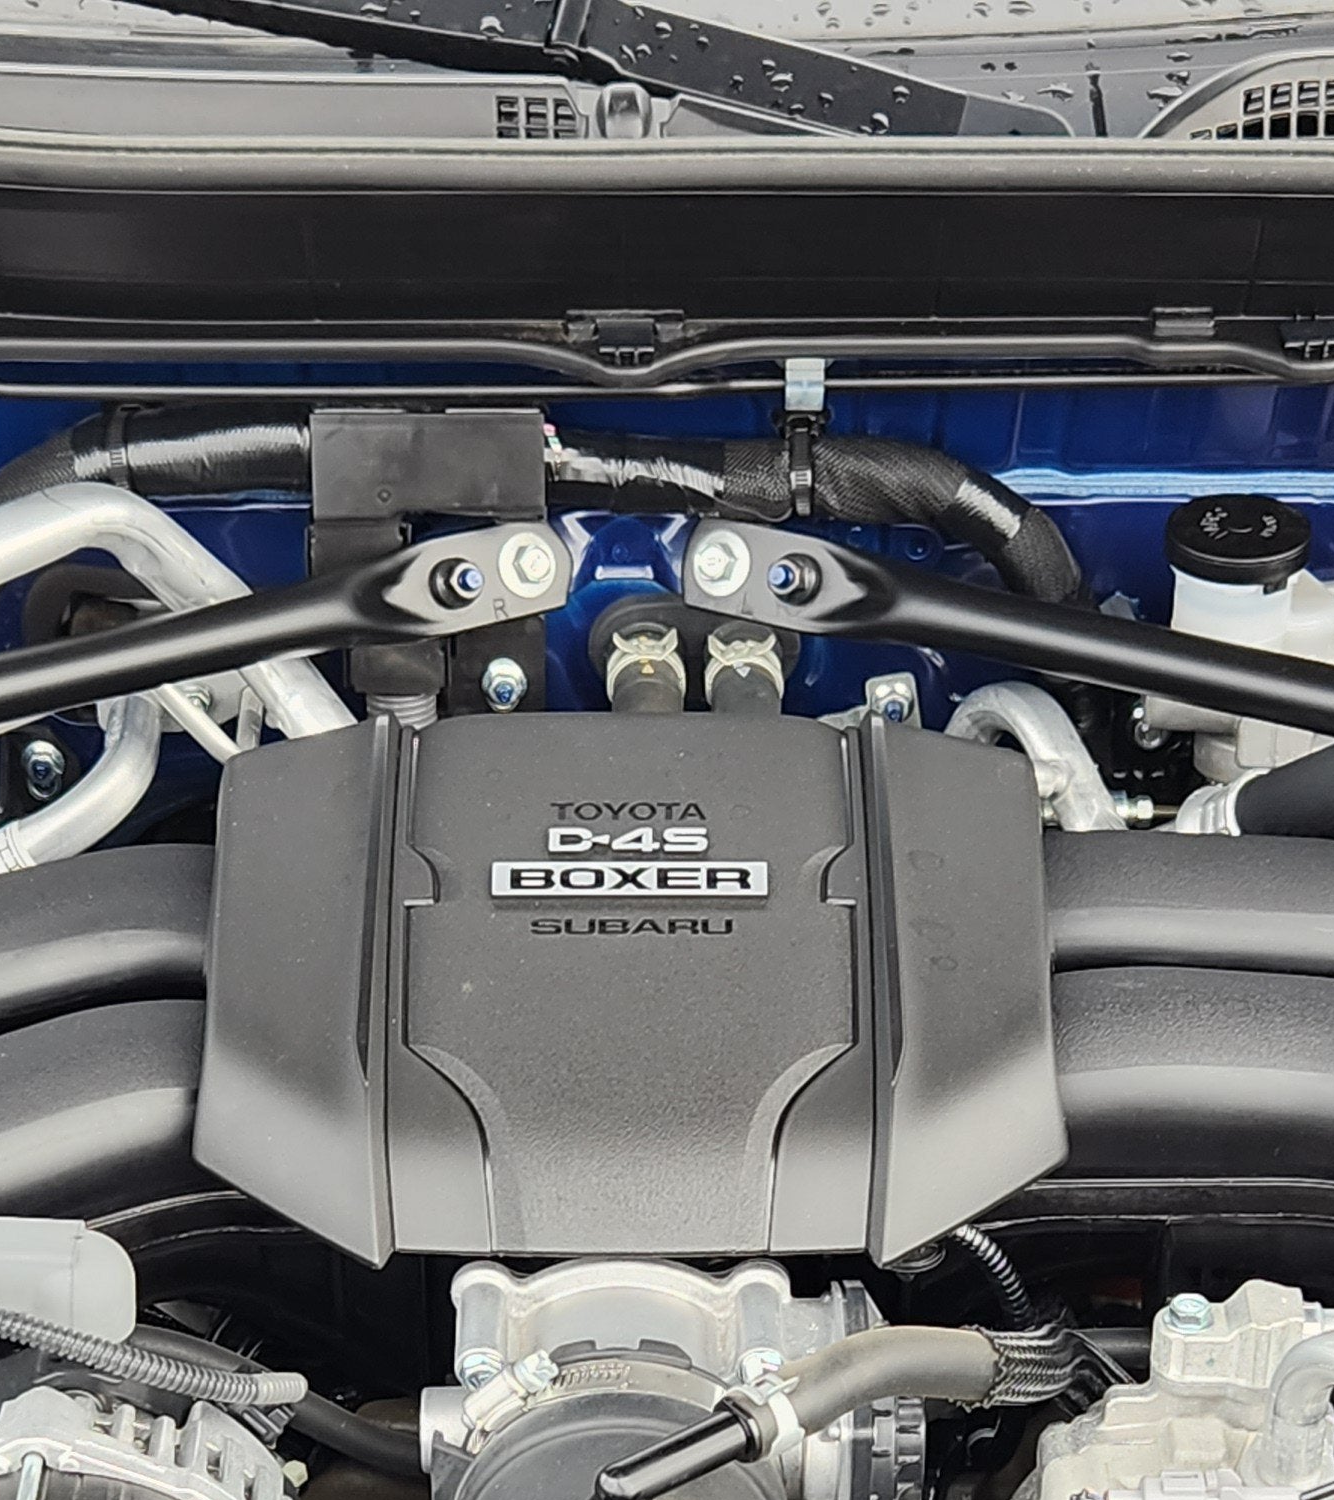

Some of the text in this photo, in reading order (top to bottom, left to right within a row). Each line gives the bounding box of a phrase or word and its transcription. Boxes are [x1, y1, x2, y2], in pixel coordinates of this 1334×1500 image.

[492, 598, 509, 620] R
[551, 802, 706, 821] TOYOTA
[547, 827, 708, 853] D-4S
[510, 868, 751, 889] BOXER
[531, 918, 734, 935] SUBARU
